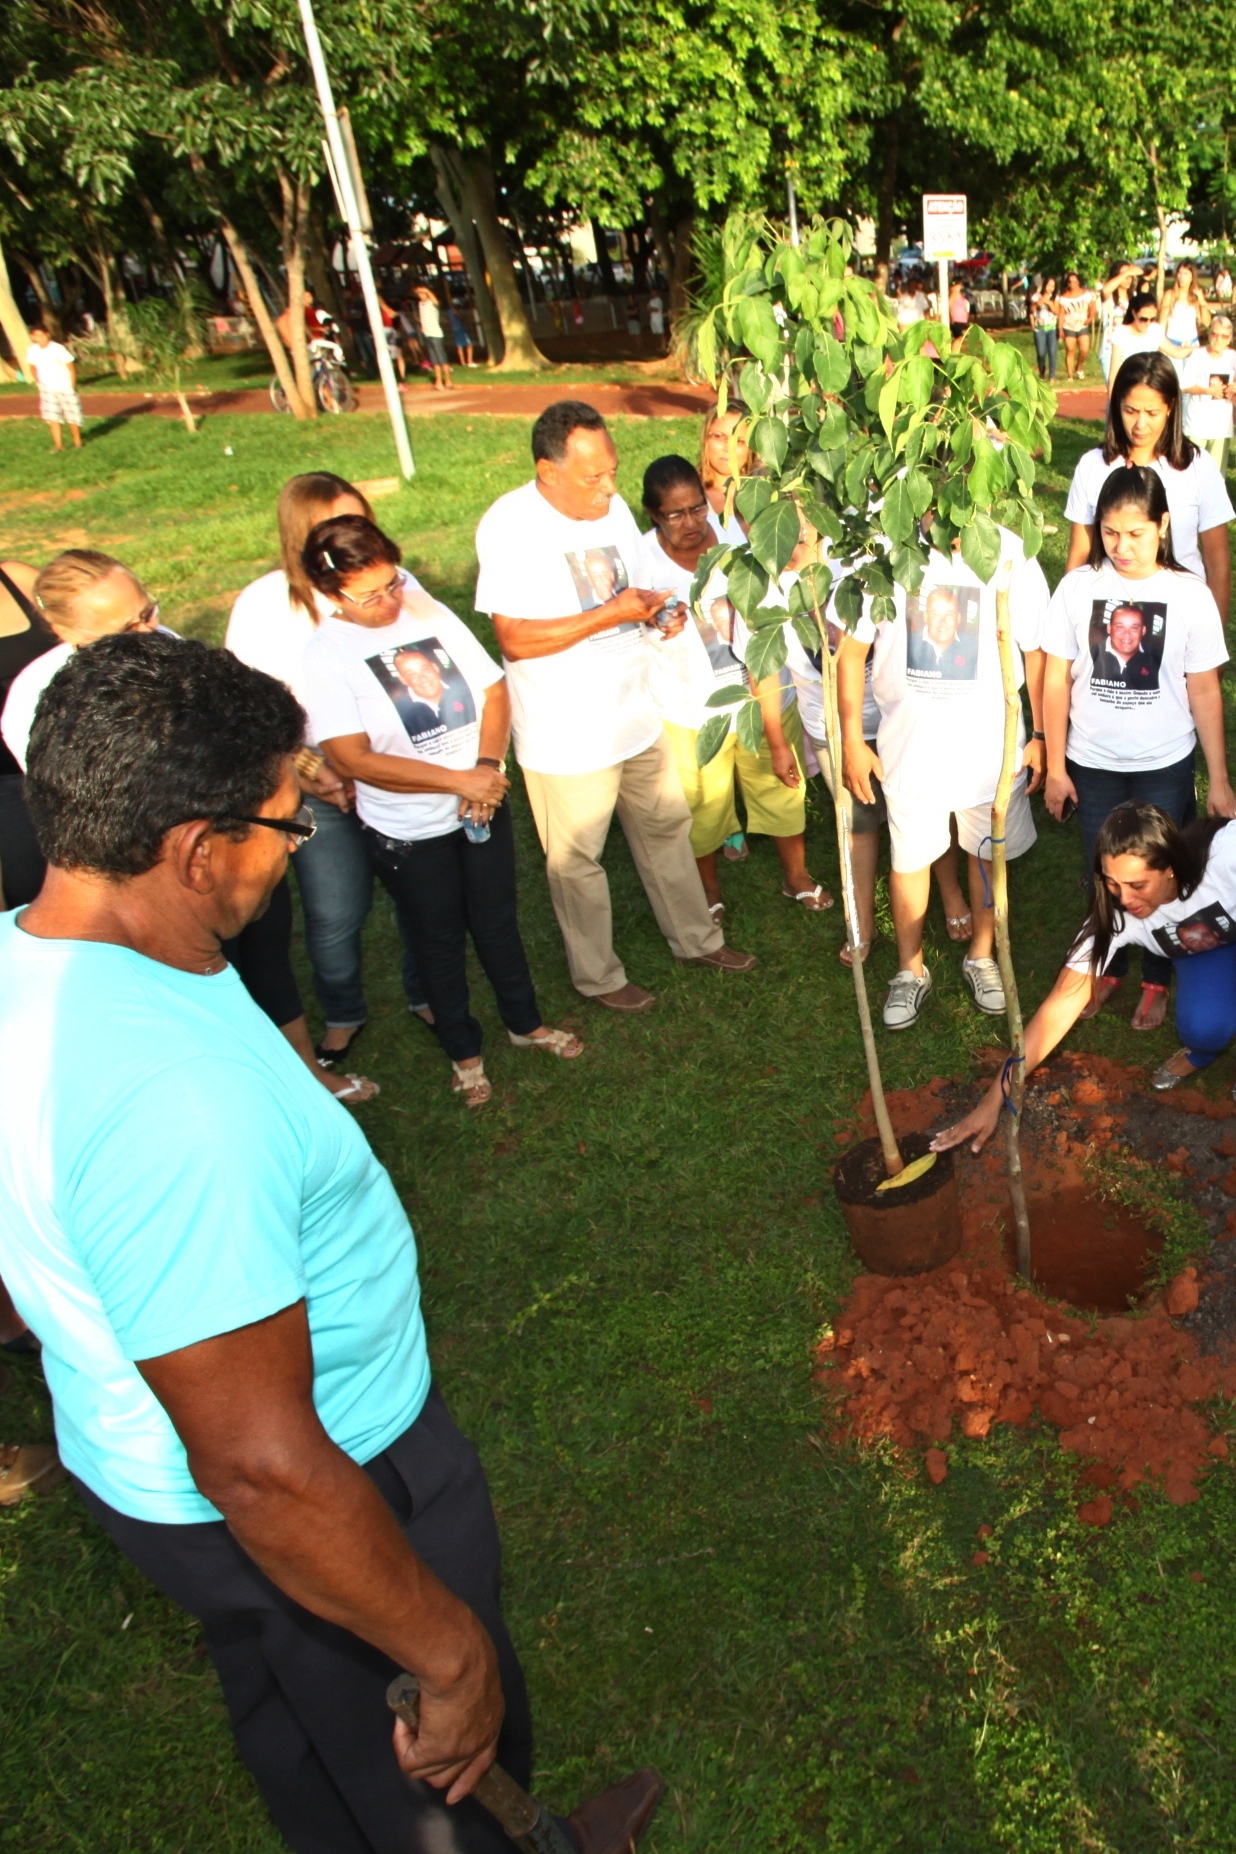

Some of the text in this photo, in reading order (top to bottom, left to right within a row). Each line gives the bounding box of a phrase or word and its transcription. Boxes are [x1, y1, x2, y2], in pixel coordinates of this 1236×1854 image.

[907, 668, 943, 679] FABIANO
[1091, 677, 1127, 688] FABIANO
[411, 724, 448, 743] FABIANO
